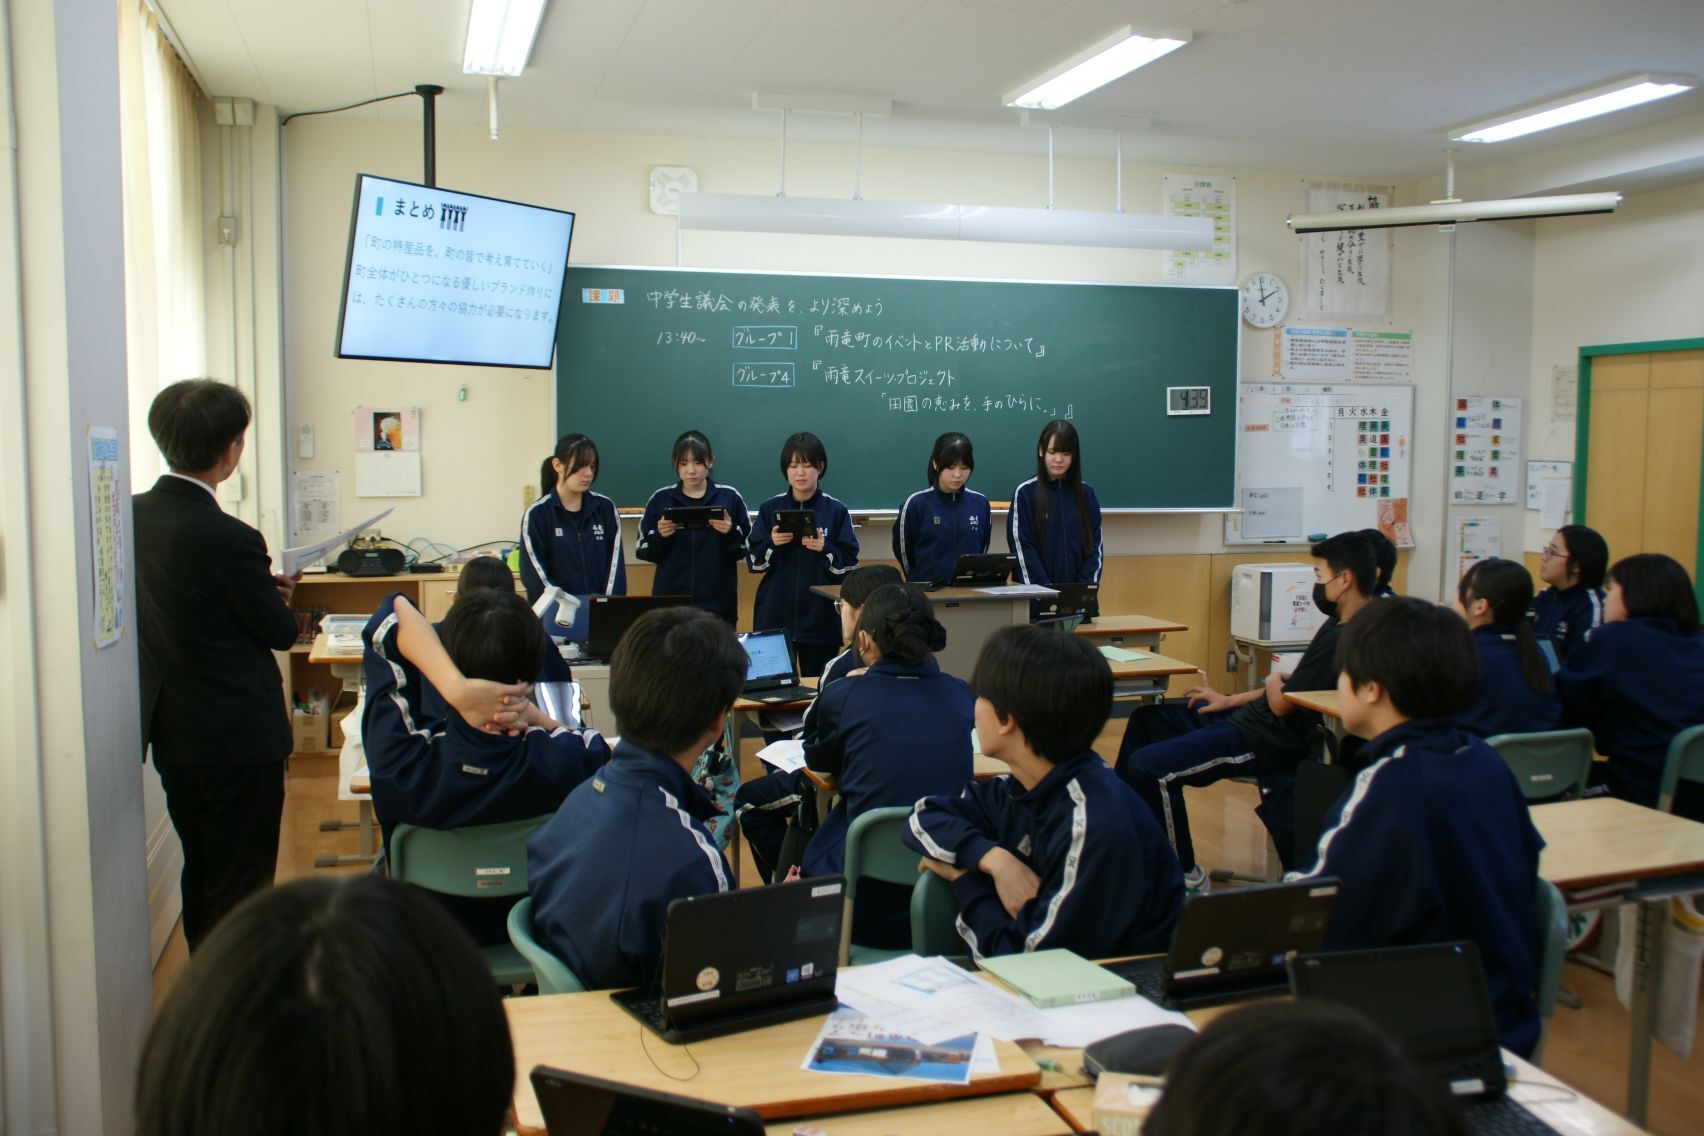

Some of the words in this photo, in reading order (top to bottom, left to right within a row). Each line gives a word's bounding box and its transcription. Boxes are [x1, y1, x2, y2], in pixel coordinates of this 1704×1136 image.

[393, 198, 436, 221] まとめ
[354, 263, 553, 300] 町全体がひとつになる優しいブランド作りに
[351, 290, 554, 324] は、たくさんの方々の協力が必要になります。
[646, 288, 884, 317] 中学生議会の発表を、より深めよう
[735, 327, 794, 346] グループ1
[814, 324, 1045, 358] 『雨竜町のイベントとPR活動について』
[735, 365, 791, 384] グループ4
[1338, 408, 1344, 417] 月
[1350, 407, 1356, 416] 火
[1360, 408, 1367, 417] 水
[1369, 408, 1377, 416] 木
[1380, 408, 1388, 417] 金
